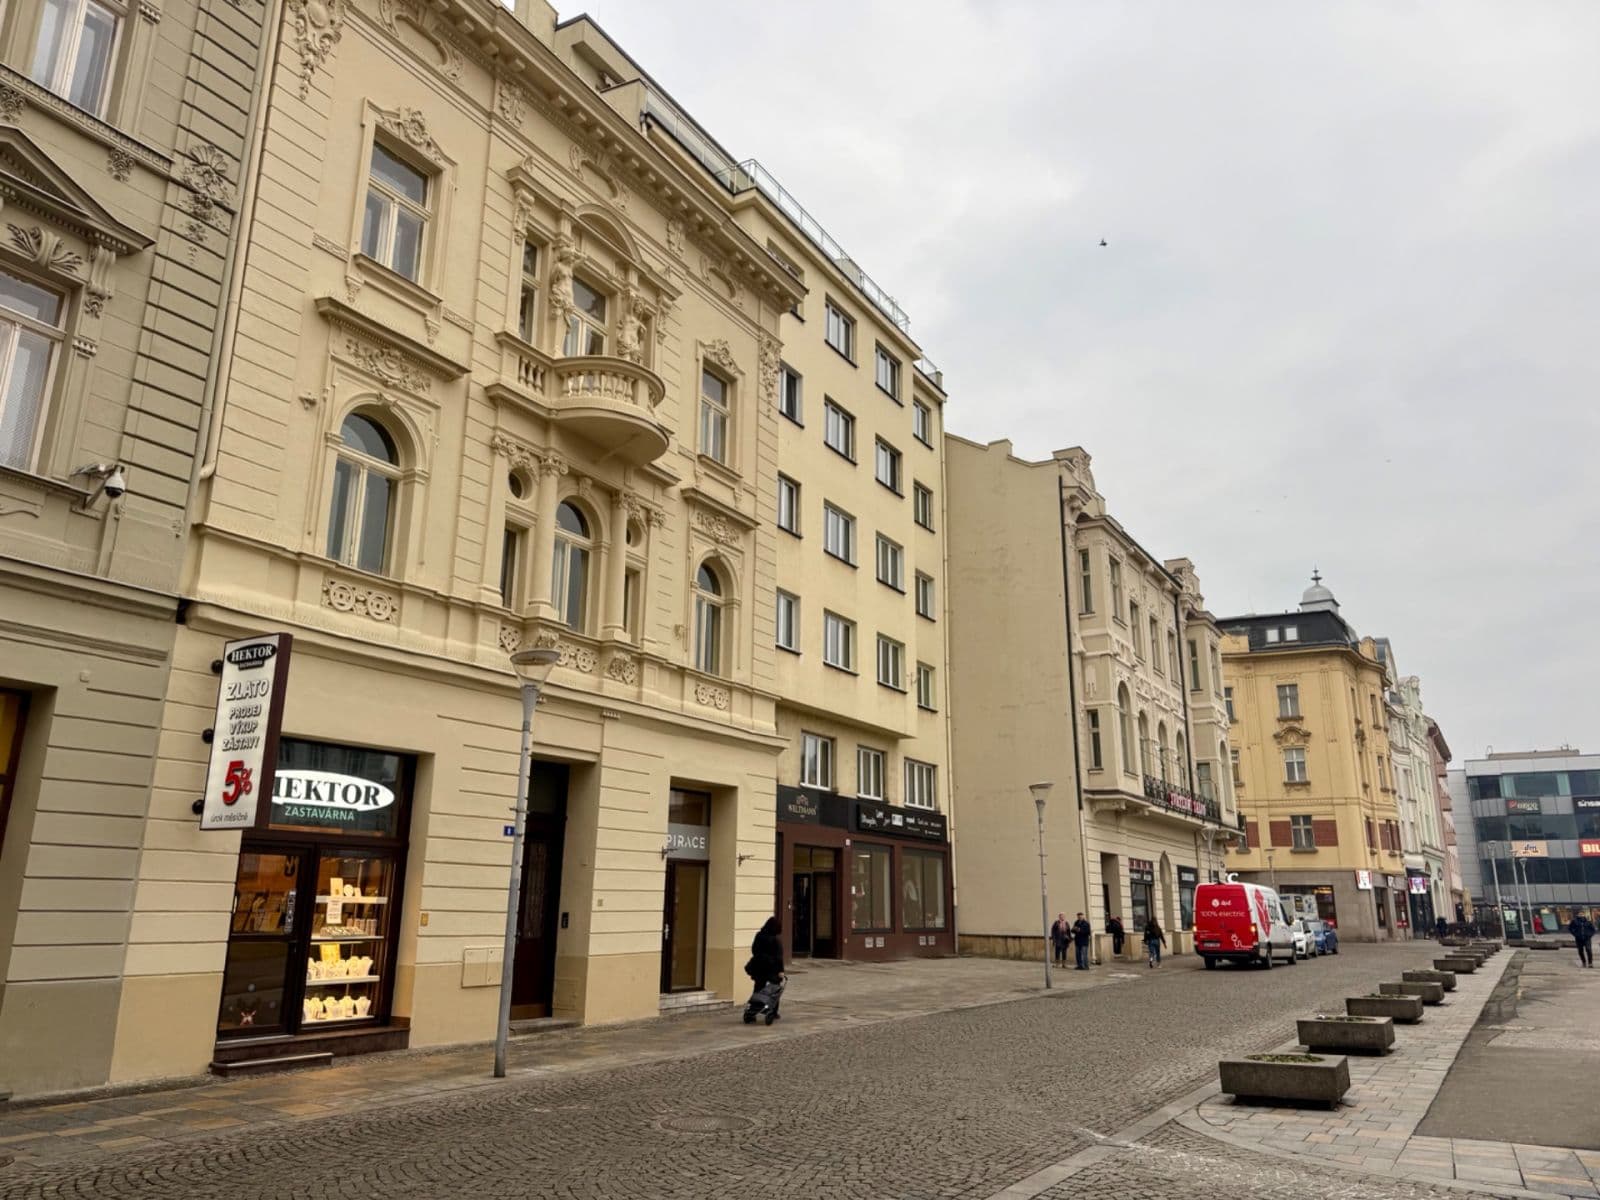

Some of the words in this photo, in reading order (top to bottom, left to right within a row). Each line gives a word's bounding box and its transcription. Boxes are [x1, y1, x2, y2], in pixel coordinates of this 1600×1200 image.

[231, 645, 273, 662] HEKTOR
[225, 680, 270, 701] ZLATO
[222, 760, 253, 807] 5%
[284, 806, 355, 821] ZASTAVÁRNA
